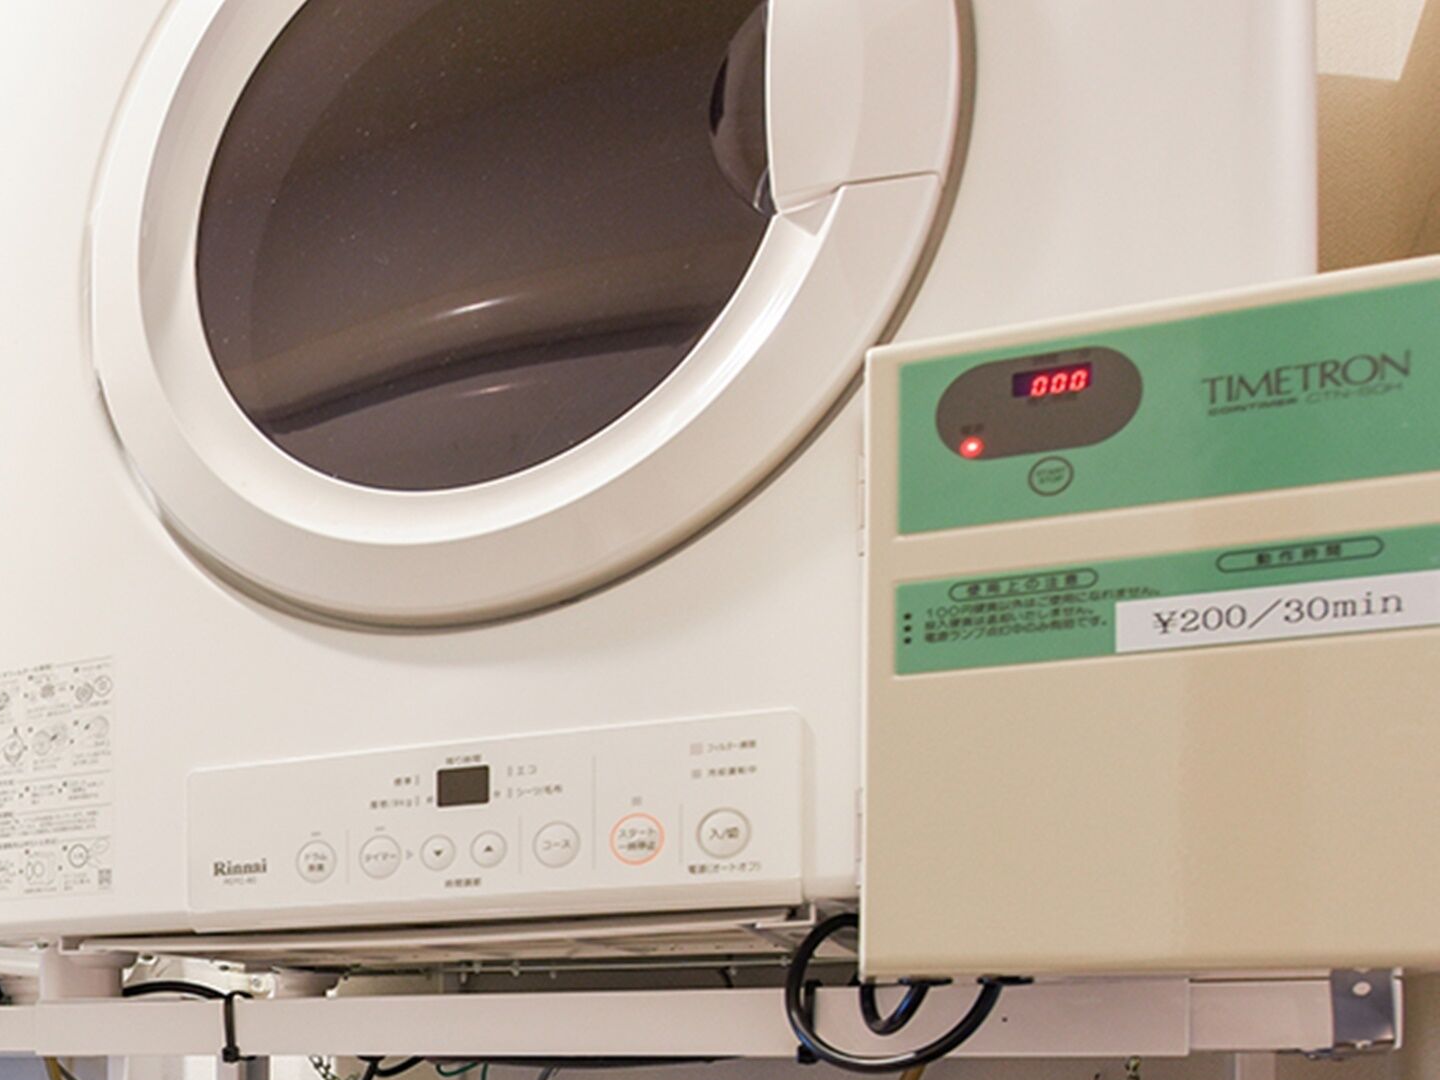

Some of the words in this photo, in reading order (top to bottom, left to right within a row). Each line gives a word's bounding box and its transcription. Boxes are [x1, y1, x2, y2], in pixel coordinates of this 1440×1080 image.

[1030, 368, 1089, 397] 000
[1202, 350, 1410, 404] TIMETRON
[1153, 591, 1403, 635] ¥200/30min
[212, 857, 268, 877] Rinnai
